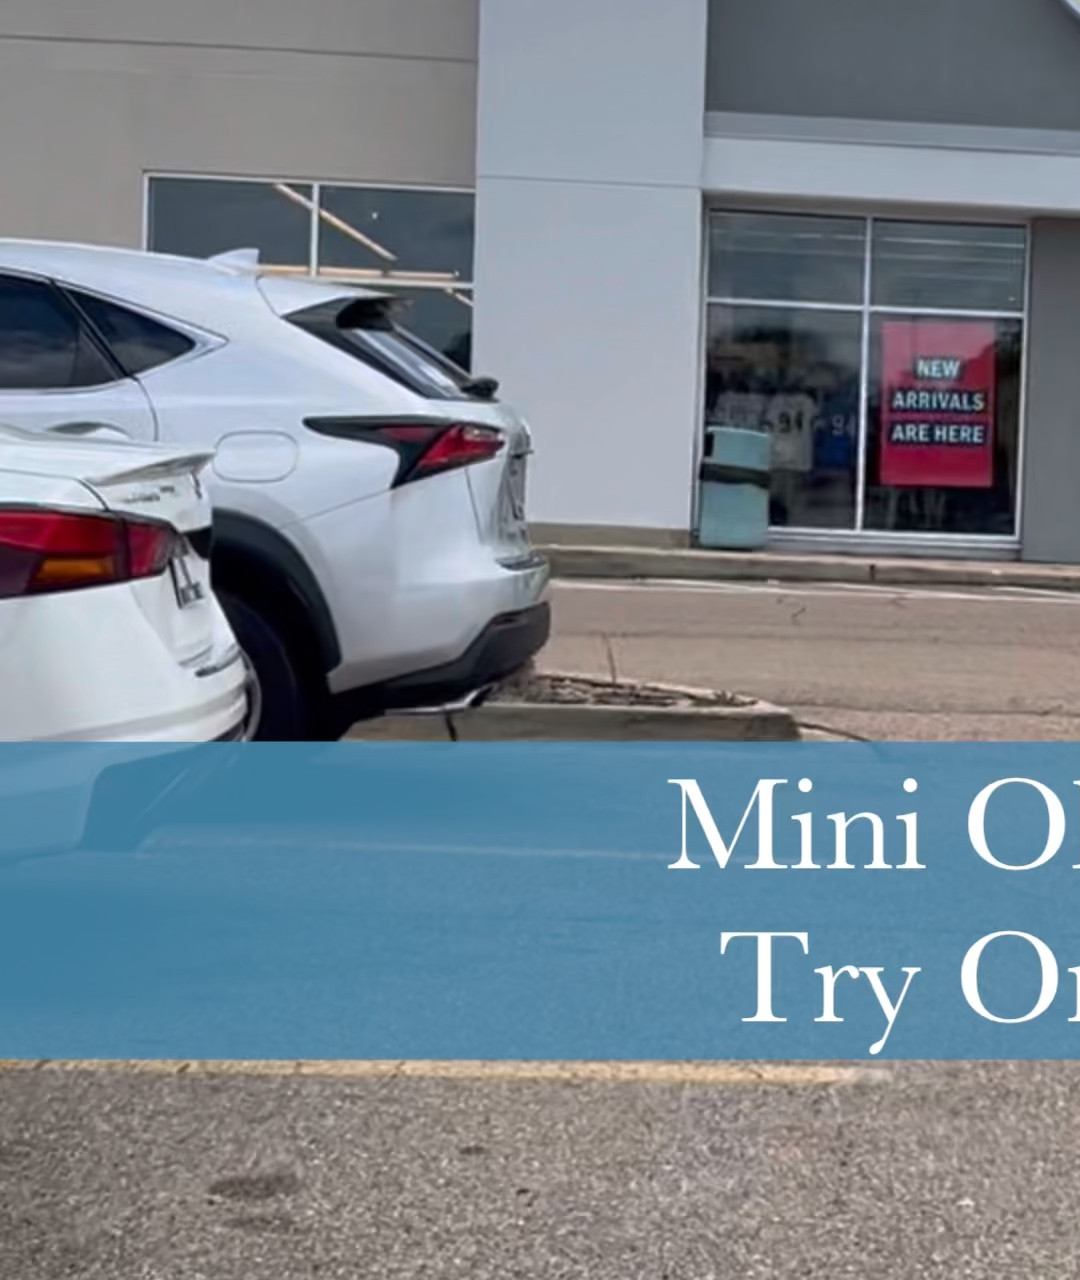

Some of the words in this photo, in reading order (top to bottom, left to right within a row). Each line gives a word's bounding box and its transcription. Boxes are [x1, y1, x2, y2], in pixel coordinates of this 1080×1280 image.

[915, 358, 961, 379] NEW
[892, 391, 985, 411] ARRIVALS
[892, 424, 930, 442] ARE
[934, 425, 983, 443] HERE
